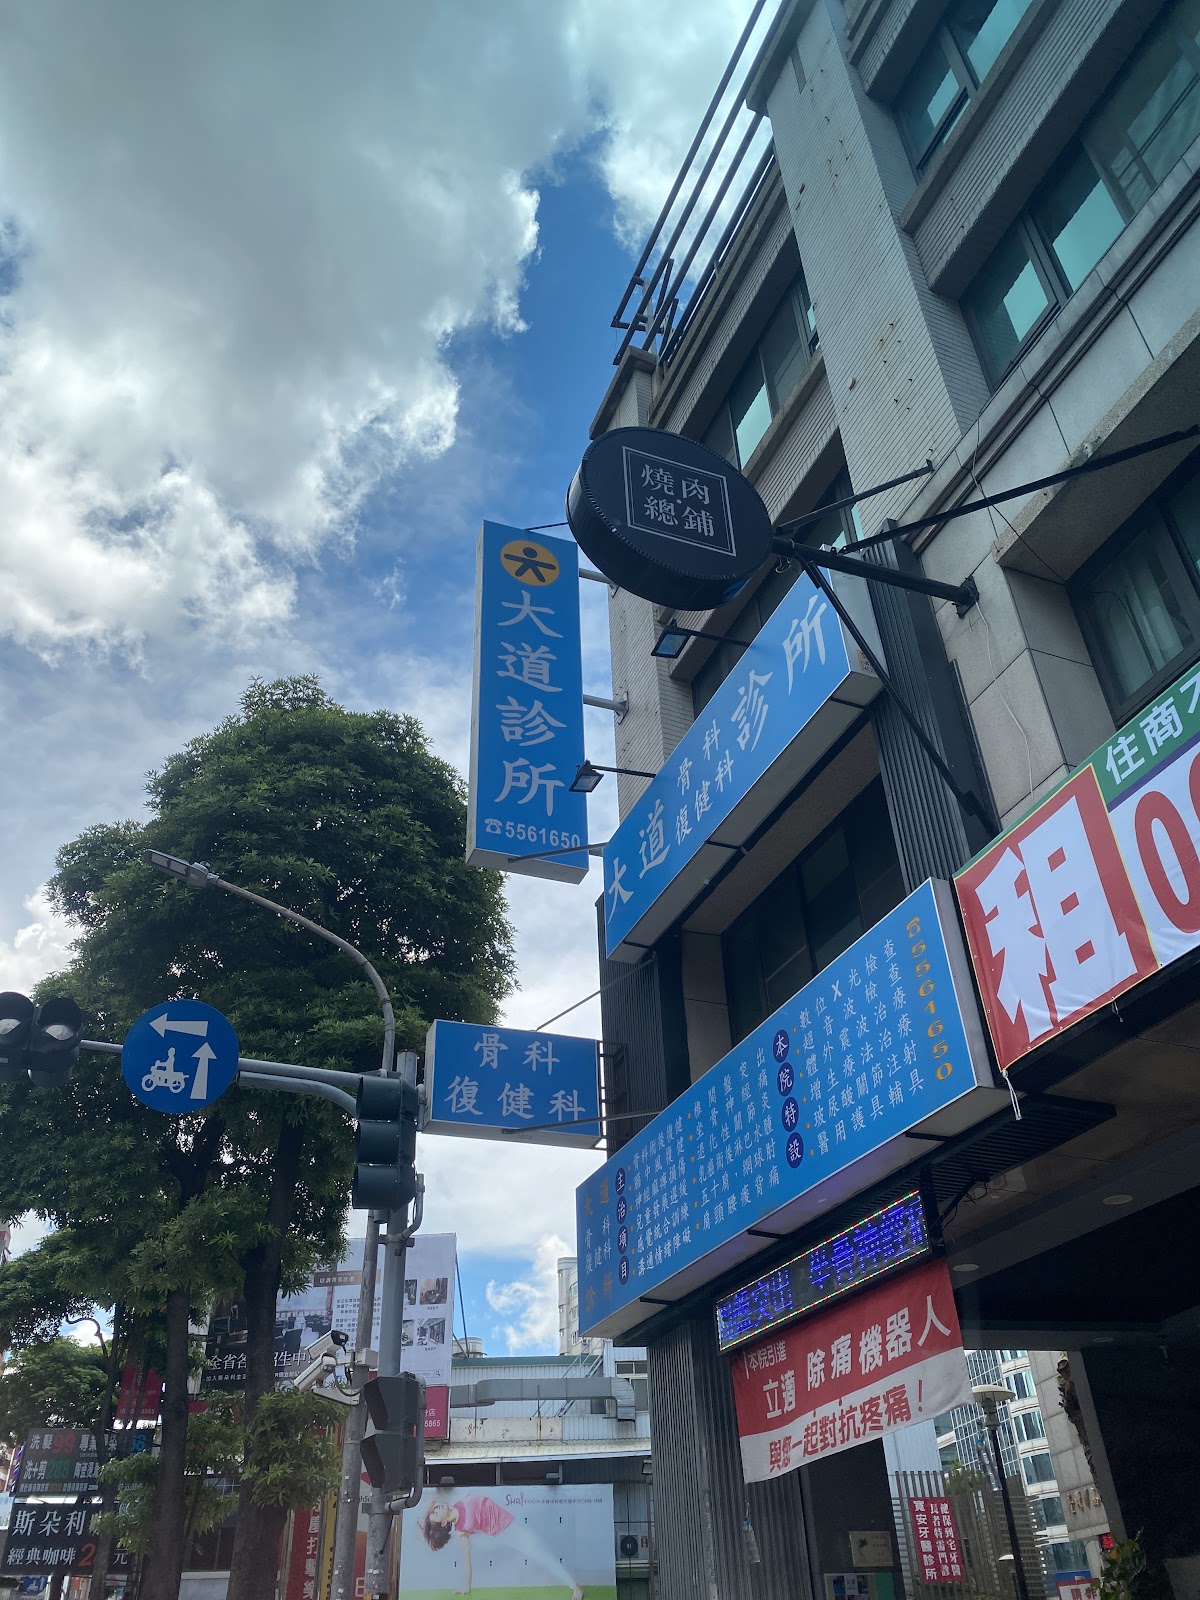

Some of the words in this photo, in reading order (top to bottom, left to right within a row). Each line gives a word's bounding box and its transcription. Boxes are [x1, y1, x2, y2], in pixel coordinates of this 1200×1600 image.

[641, 464, 710, 505] 燒肉
[644, 496, 714, 536] 總鋪
[494, 589, 568, 818] 大道診所
[675, 749, 734, 846] 復健科
[676, 718, 720, 796] 骨科
[505, 821, 580, 849] 5561650
[1134, 750, 1200, 934] 0
[974, 795, 1138, 1044] 租
[799, 938, 897, 1029] 數位X光檢查
[802, 963, 902, 1053] 超音波檢查
[911, 938, 953, 1081] 5561650
[474, 1033, 560, 1075] 骨科
[805, 987, 907, 1078] 體外震波治療
[809, 1013, 912, 1102] 增生療法治療
[444, 1075, 586, 1122] 復健科
[694, 1048, 765, 1120] 椎間盤突出
[695, 1069, 768, 1141] 坐骨神經痛
[697, 1092, 771, 1161] 退化性關節炎
[775, 1034, 802, 1162] 本院特設
[813, 1040, 918, 1128] 玻尿酸關節注射
[817, 1068, 925, 1156] 醫用護具輔具
[616, 1172, 628, 1279] 主治項目
[748, 1340, 787, 1371] 本院引進
[807, 1295, 951, 1391] 除痛機器人
[424, 1419, 441, 1427] 5865
[913, 1501, 937, 1580] 寬安牙醫診所
